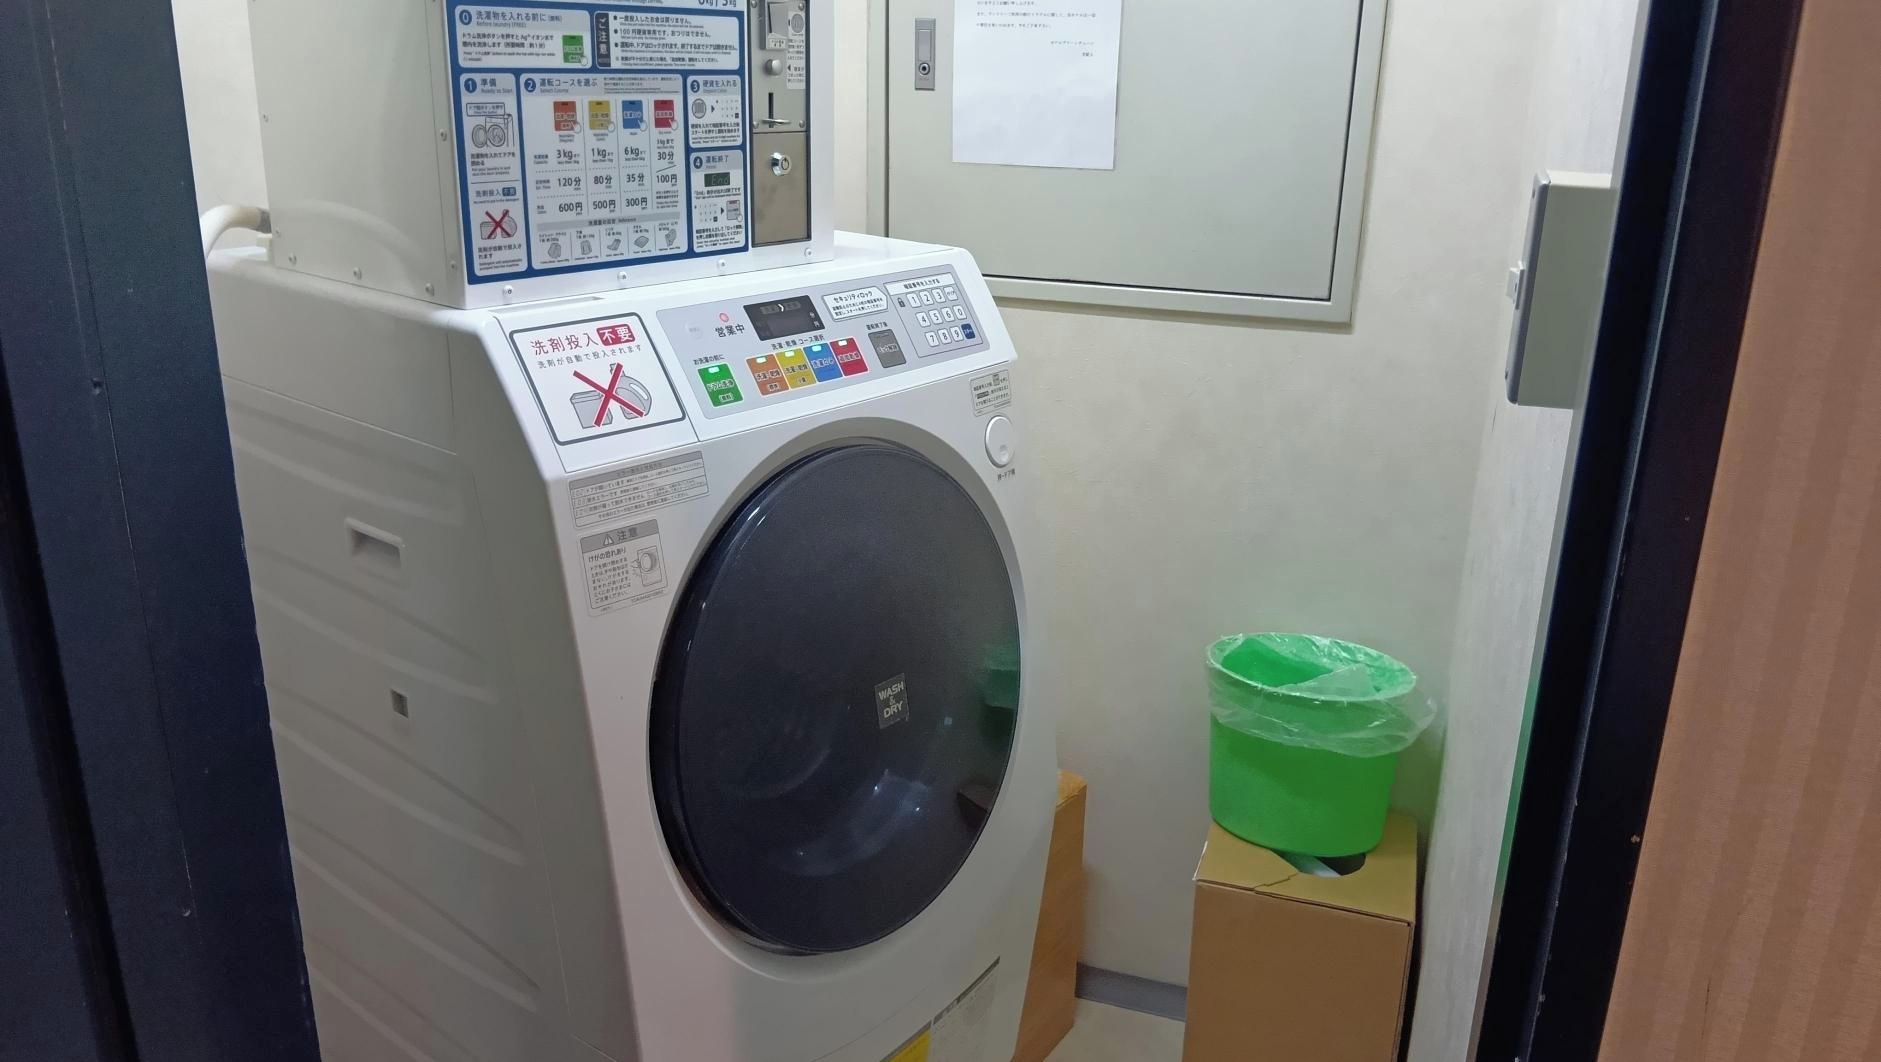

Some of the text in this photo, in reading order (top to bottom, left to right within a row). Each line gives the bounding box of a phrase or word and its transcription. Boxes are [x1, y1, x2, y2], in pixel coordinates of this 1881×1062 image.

[476, 10, 547, 22] 洗濯物を入れる前に
[480, 78, 497, 87] 準備
[527, 80, 534, 91] 2
[539, 77, 598, 88] 運転コースを選ぶ
[703, 79, 737, 88] 硬貨を入れる
[705, 155, 729, 163] 運転終了
[557, 177, 582, 187] 120分
[593, 175, 612, 185] 80分
[626, 173, 645, 183] 35分
[656, 173, 678, 184] 100円
[558, 202, 583, 213] 600円
[592, 199, 616, 210] 500円
[625, 197, 648, 208] 300円
[833, 290, 873, 303] セキュリティロック
[912, 296, 917, 304] 1
[924, 294, 930, 302] 2
[936, 292, 942, 300] 3
[921, 316, 927, 324] 4
[933, 315, 939, 323] 5
[946, 312, 952, 320] 6
[715, 323, 745, 338] 営業中
[929, 334, 935, 343] 7
[943, 332, 948, 340] 8
[954, 329, 960, 338] 9
[530, 326, 634, 356] 洗剤投入 不要
[537, 344, 642, 369] 洗剤が自動で投入されます
[693, 353, 725, 366] お洗濯の前に
[617, 526, 638, 541] 注意
[588, 546, 626, 563] けがの恐れあり
[878, 681, 905, 701] WASH
[889, 695, 896, 706] &
[883, 700, 904, 719] DRY
